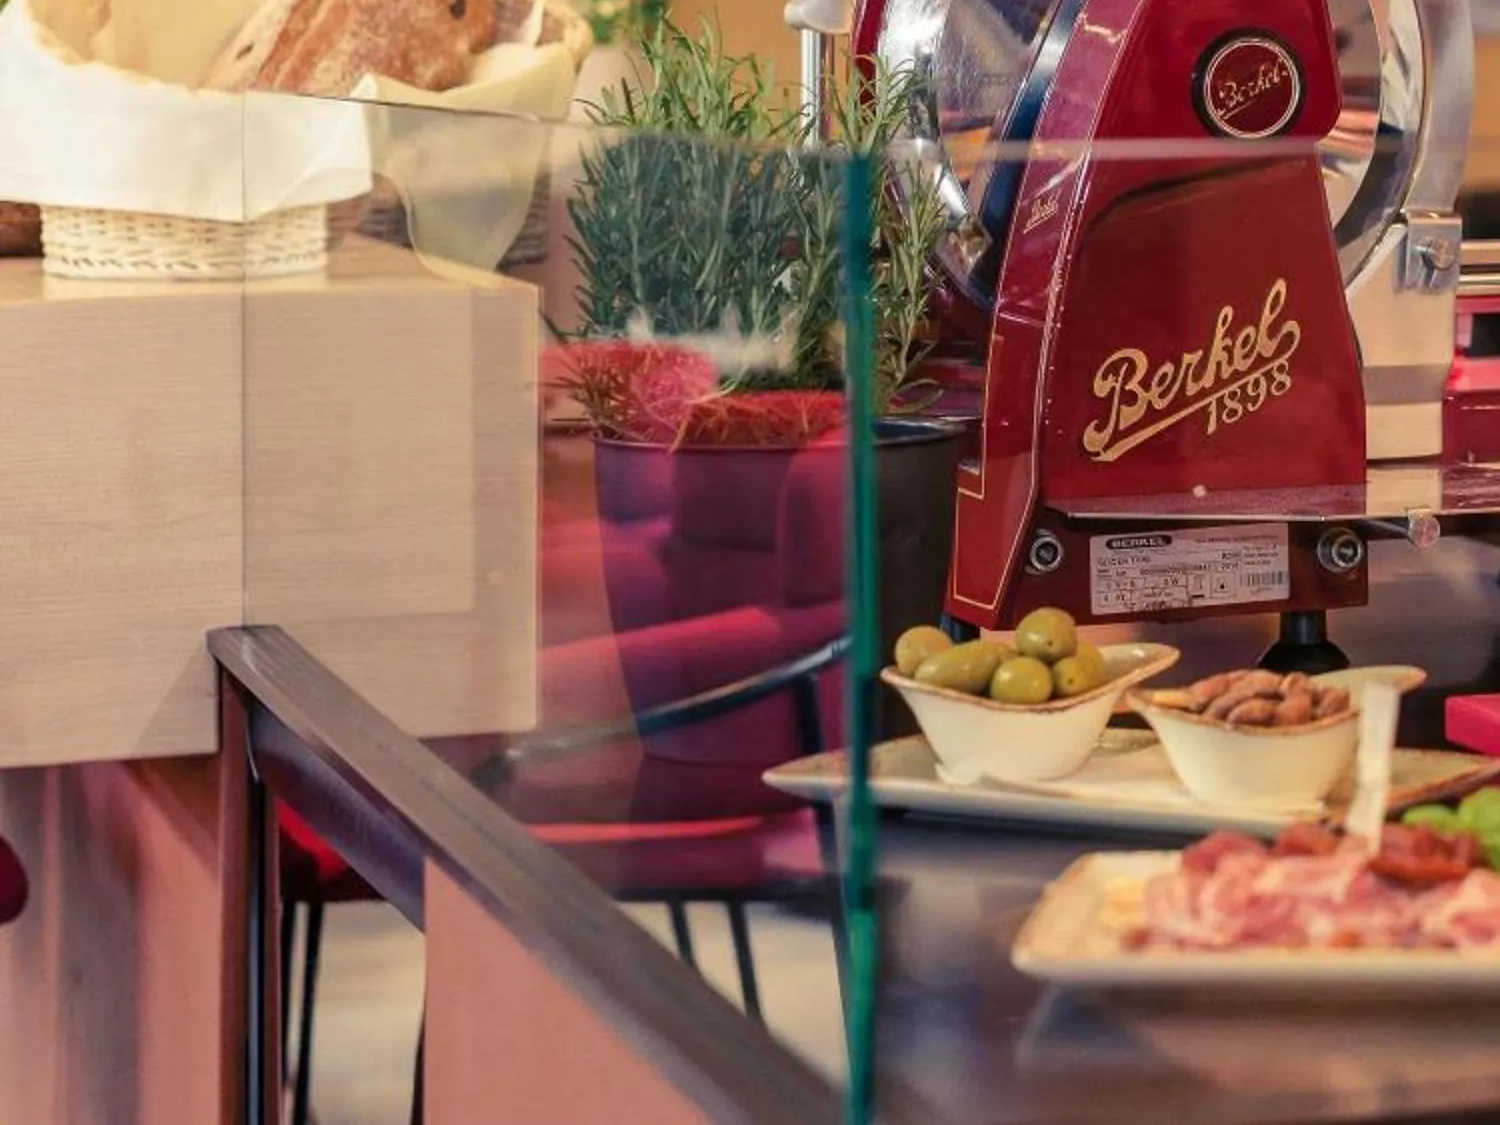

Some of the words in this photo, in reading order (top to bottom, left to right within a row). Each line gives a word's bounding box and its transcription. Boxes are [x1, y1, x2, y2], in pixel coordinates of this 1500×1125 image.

[1217, 58, 1289, 120] Berkel
[1083, 278, 1300, 462] Berkel
[1207, 360, 1292, 435] 1898
